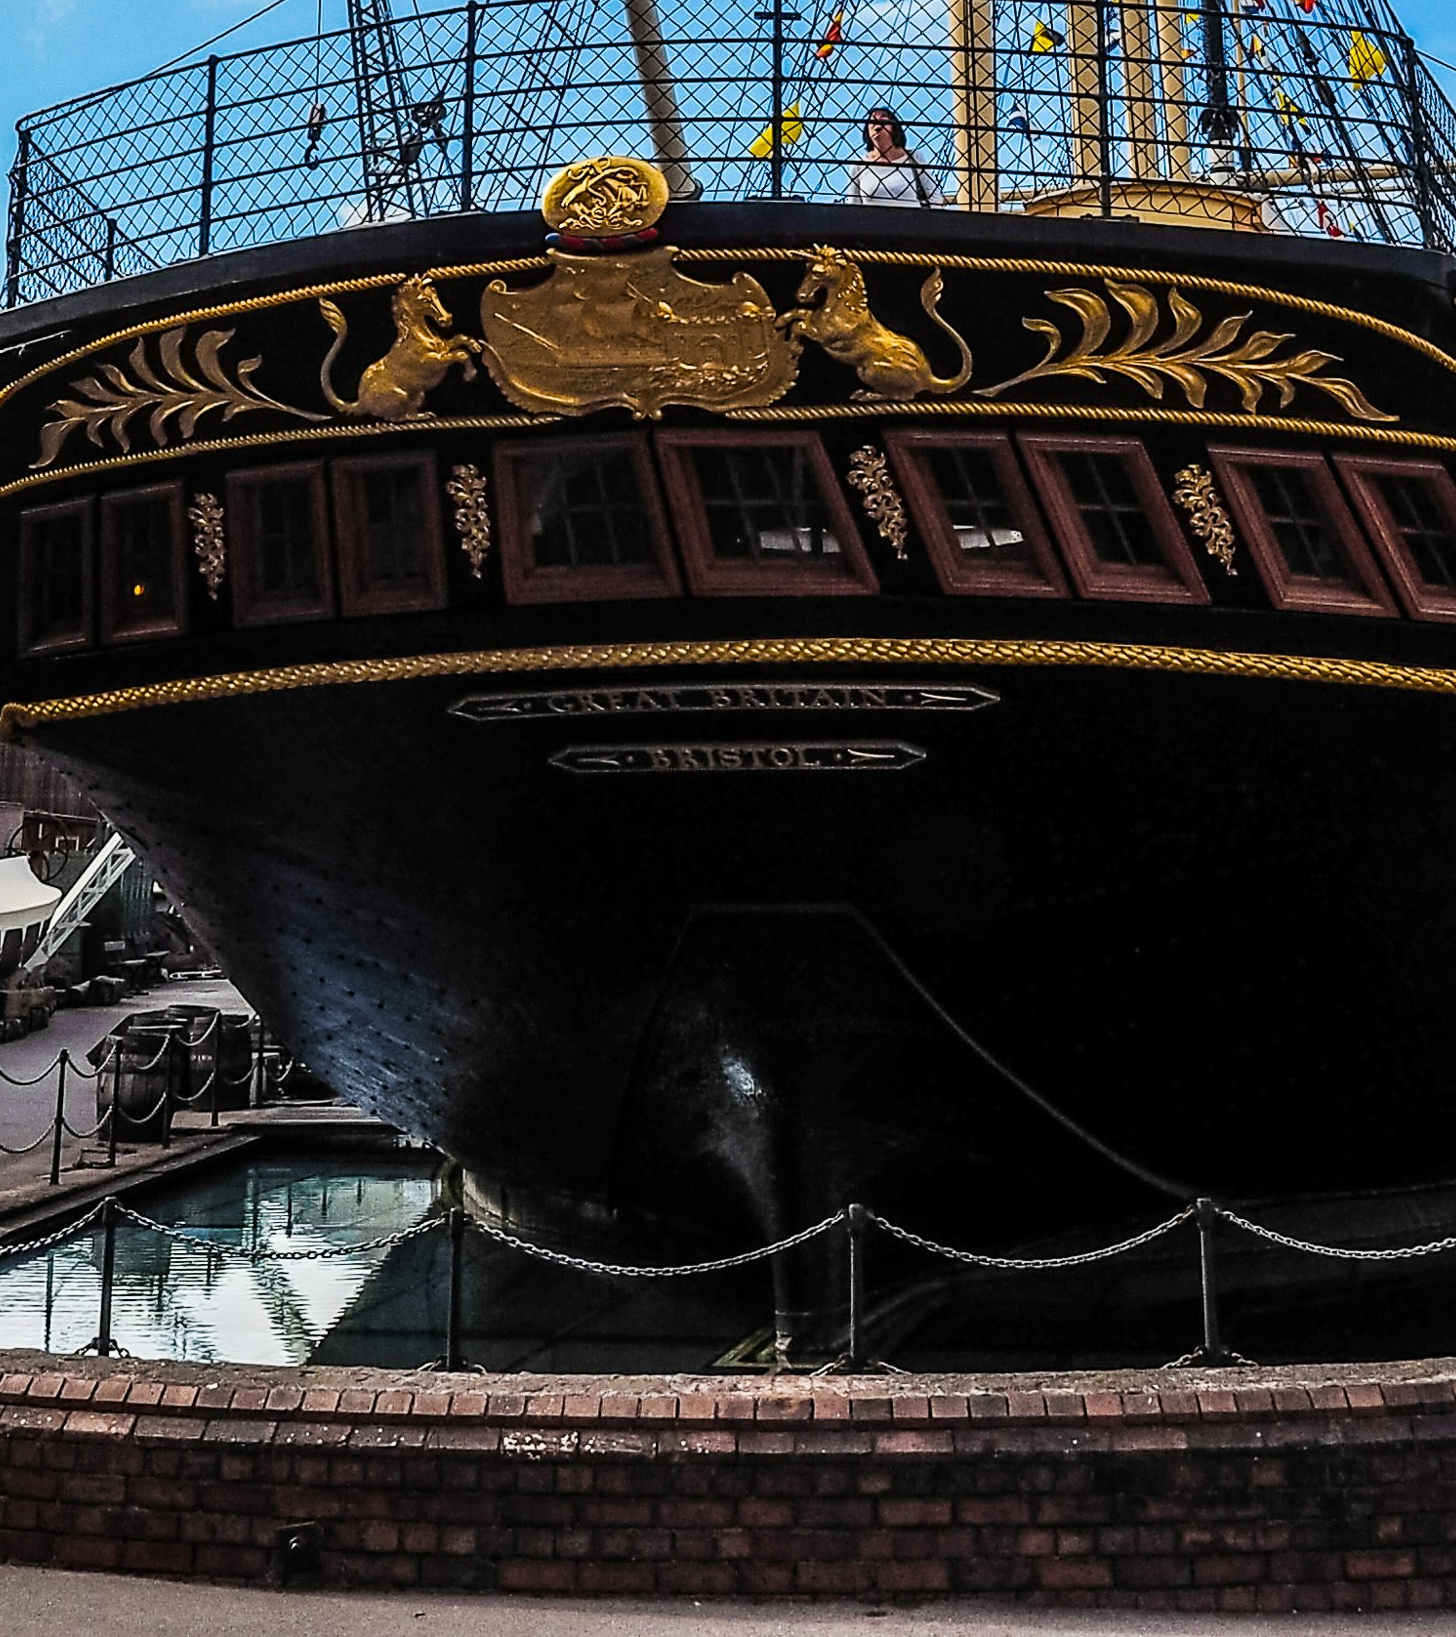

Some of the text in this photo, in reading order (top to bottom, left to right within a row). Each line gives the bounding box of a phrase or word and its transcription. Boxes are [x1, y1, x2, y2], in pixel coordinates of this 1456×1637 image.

[548, 687, 889, 713] GREAT BRITAIN
[649, 747, 821, 770] BRISTOL
